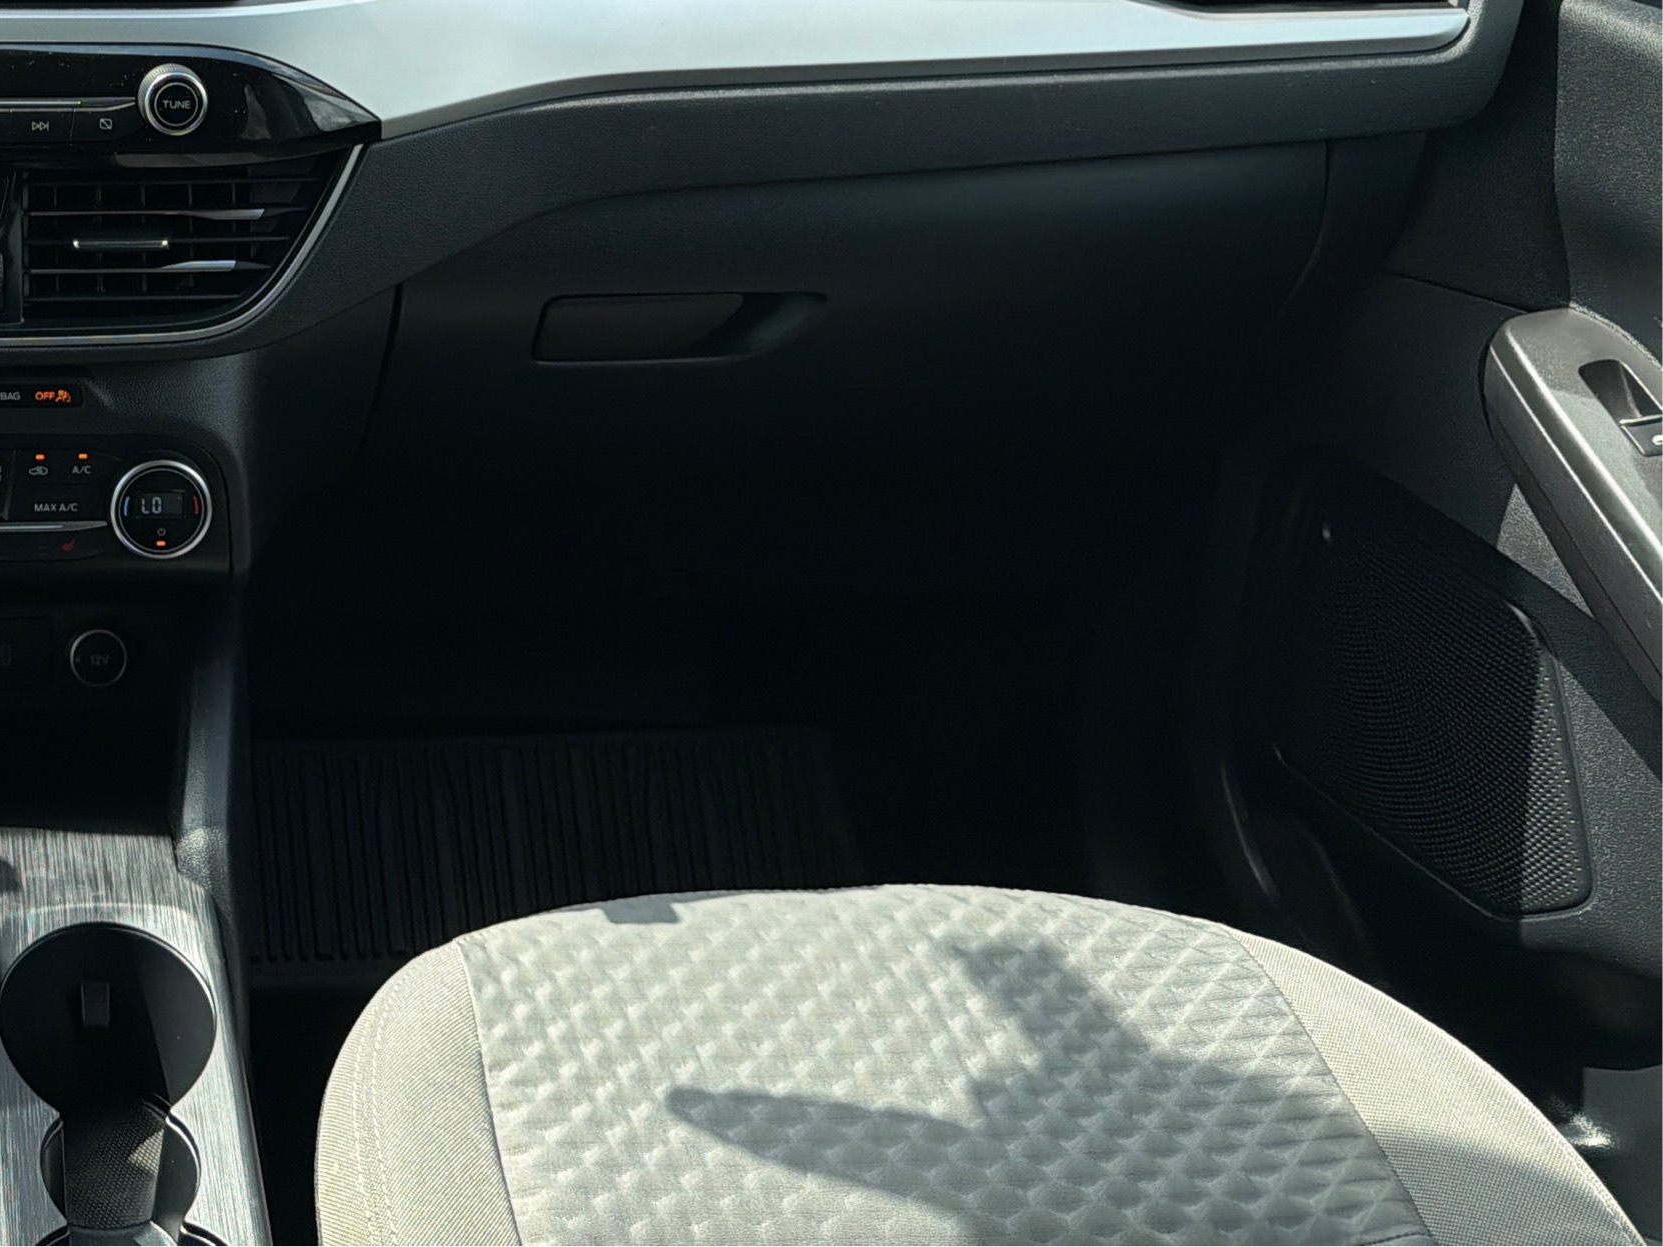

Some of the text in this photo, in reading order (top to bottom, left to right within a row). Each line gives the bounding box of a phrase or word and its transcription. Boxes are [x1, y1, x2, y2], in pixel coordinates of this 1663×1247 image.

[162, 99, 192, 110] TUNE
[35, 391, 55, 401] OFF
[71, 465, 92, 474] A/C
[34, 503, 79, 512] MAX A/C
